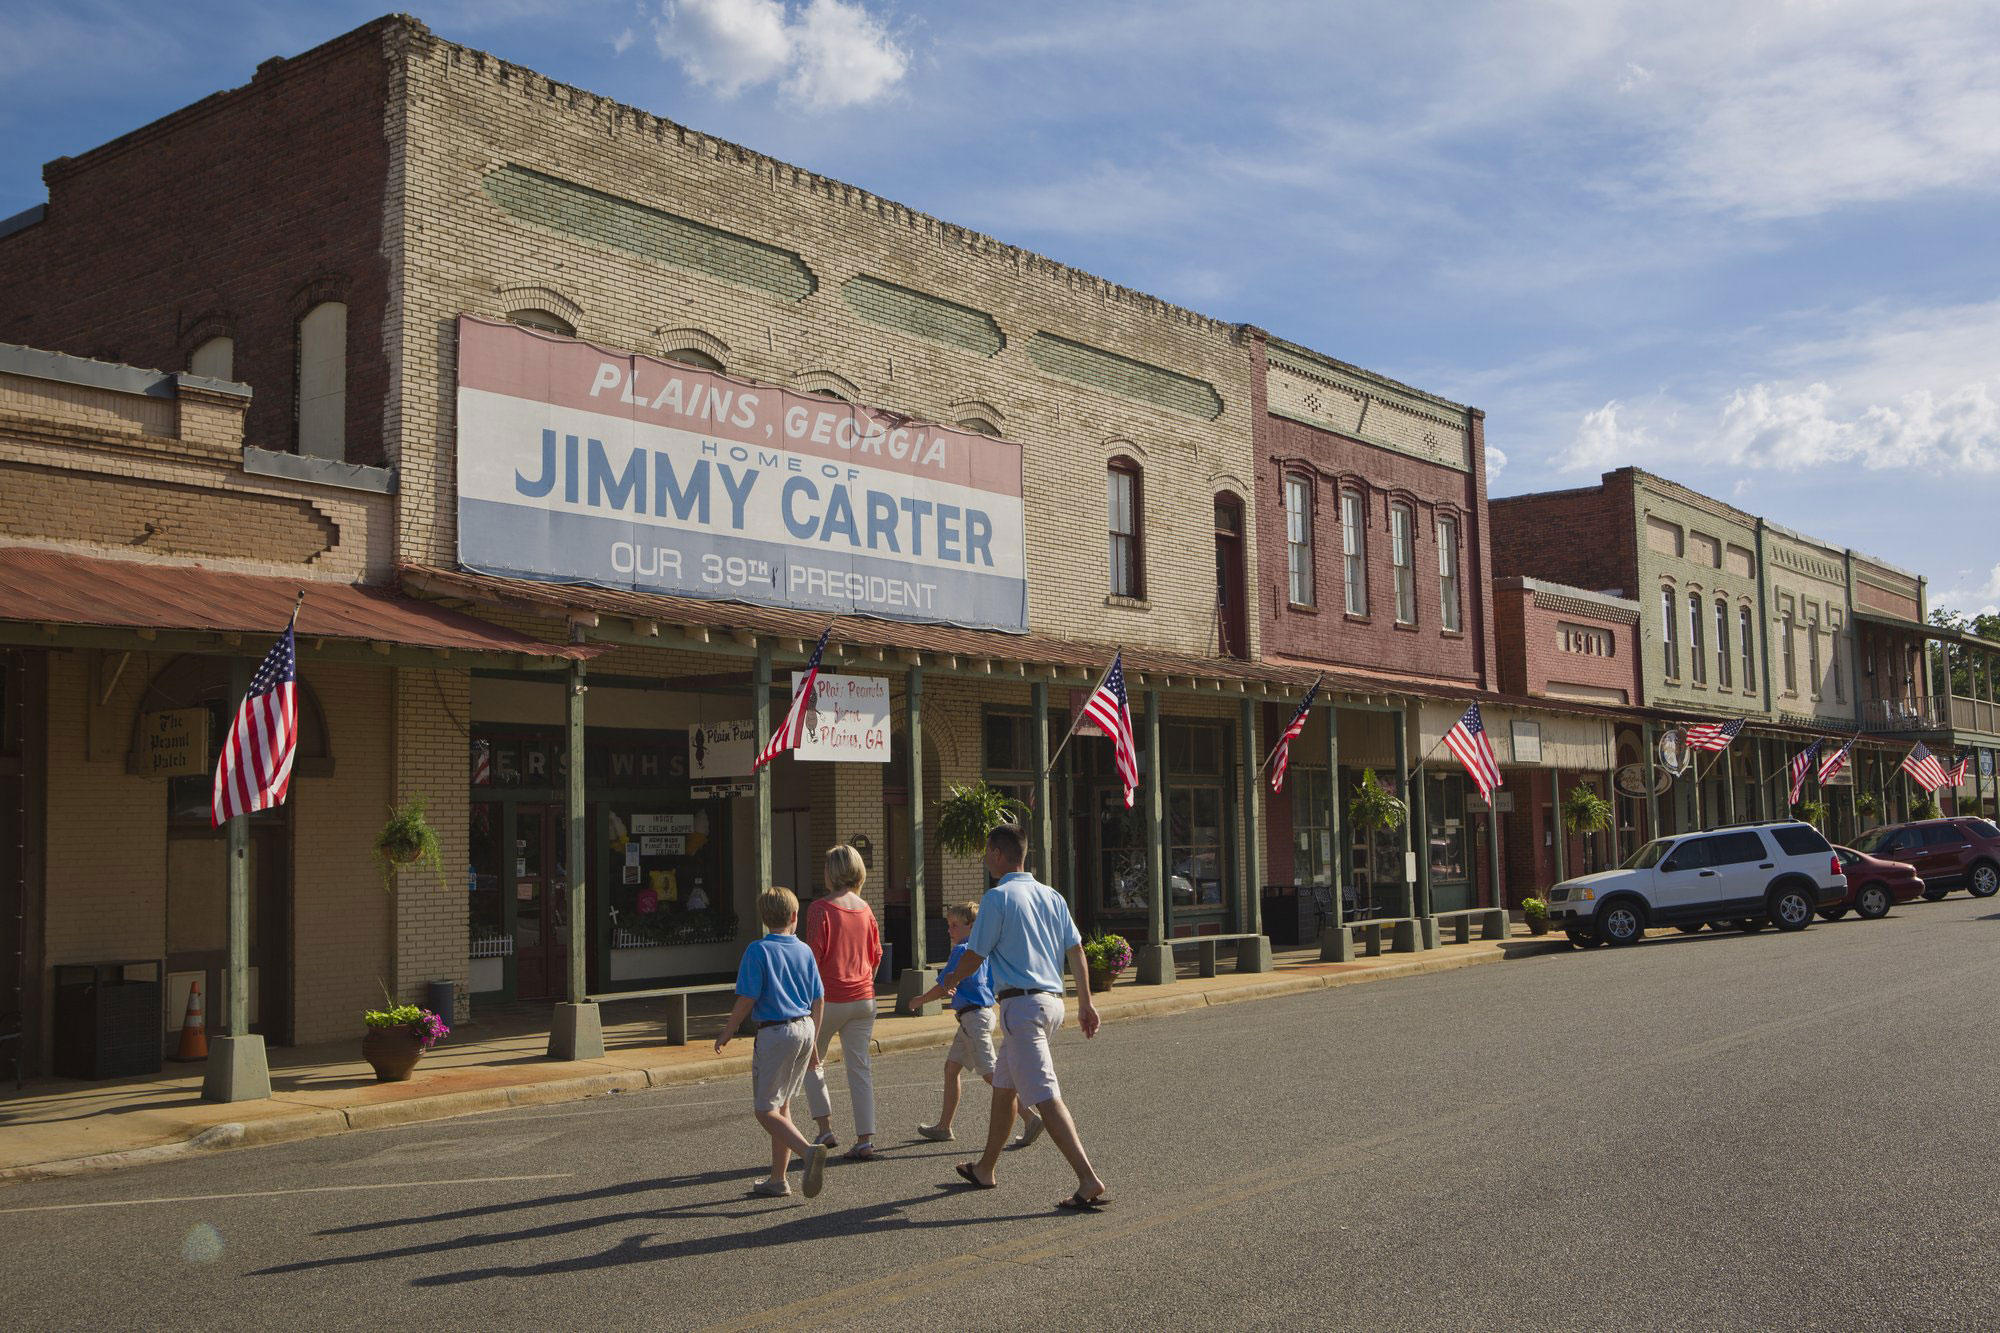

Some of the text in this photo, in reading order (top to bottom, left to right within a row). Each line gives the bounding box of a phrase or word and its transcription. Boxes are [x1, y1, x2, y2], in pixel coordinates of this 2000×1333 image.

[589, 363, 948, 470] PLAINS, GEORGIA
[702, 440, 861, 482] HOME OF
[515, 428, 995, 567] JIMMY CARTER
[610, 541, 937, 610] OUR 39TH PRESIDENT
[1565, 629, 1602, 656] 1901
[160, 714, 183, 732] The
[150, 732, 190, 752] Peanut
[706, 726, 754, 744] Plain Pean
[865, 729, 885, 750] GA
[152, 752, 187, 773] Patch
[636, 825, 646, 833] ICE
[648, 825, 668, 833] CREAM
